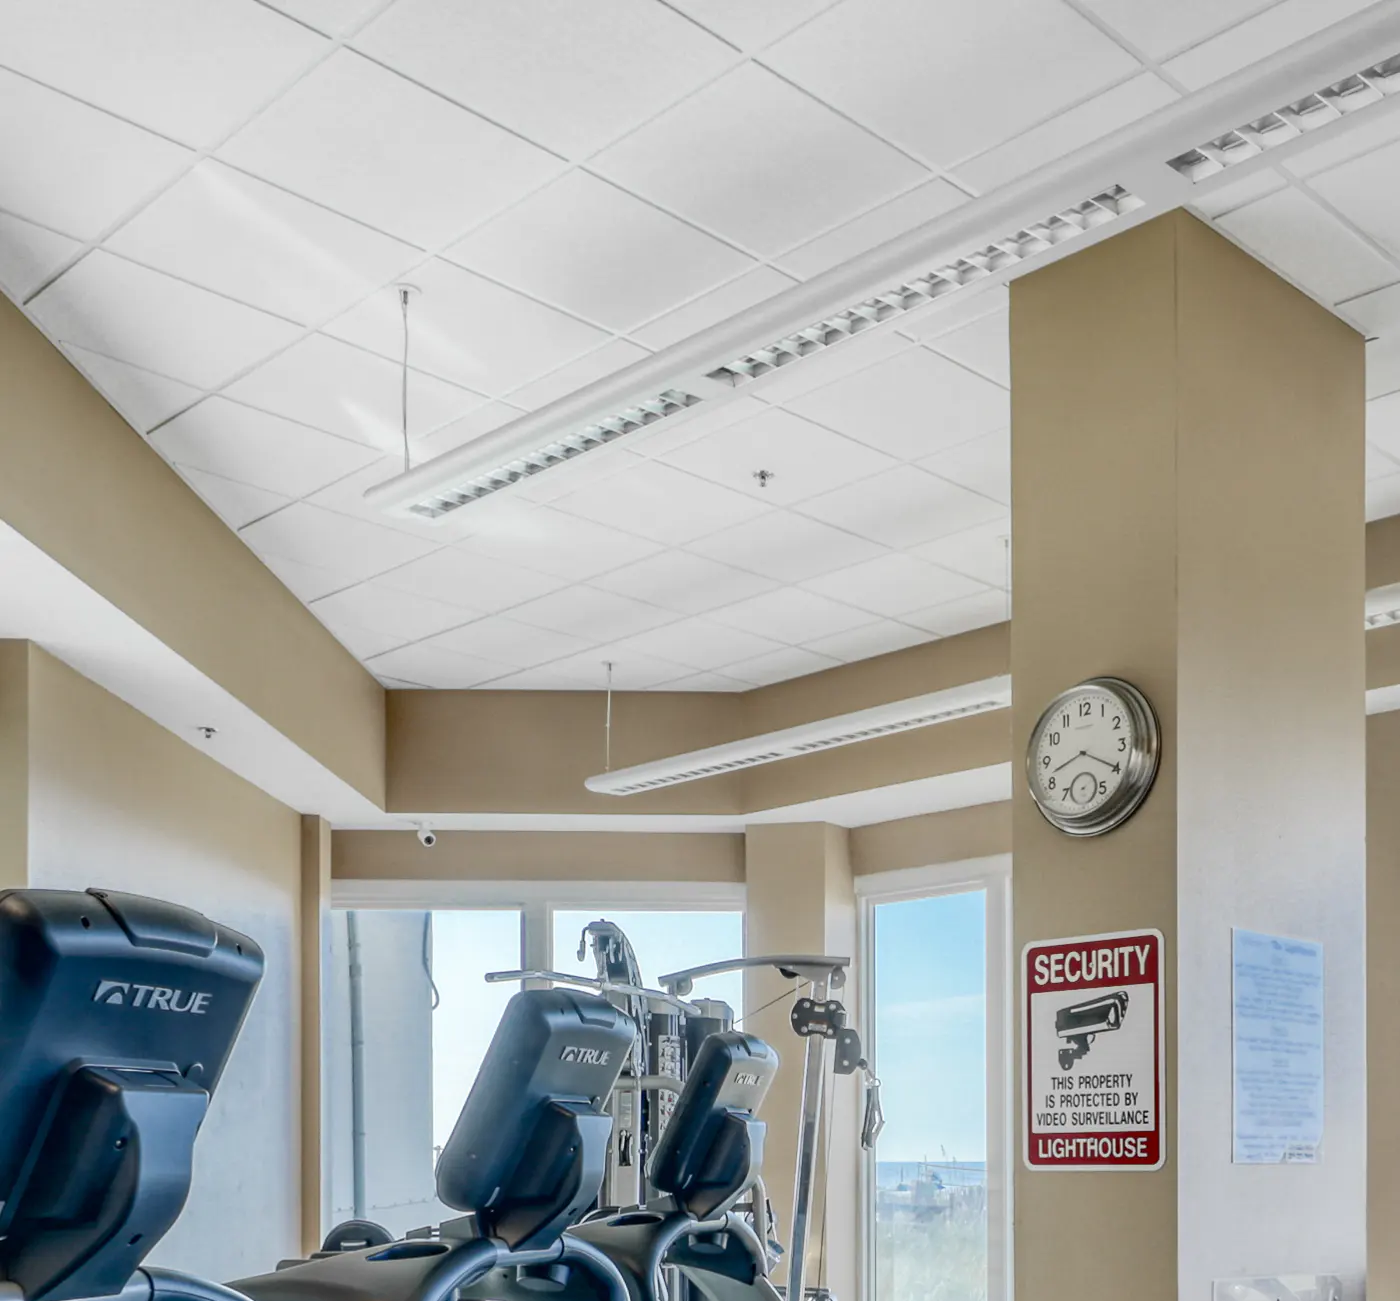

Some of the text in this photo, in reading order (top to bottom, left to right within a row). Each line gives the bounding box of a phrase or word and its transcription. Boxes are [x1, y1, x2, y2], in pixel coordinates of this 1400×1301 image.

[1079, 702, 1092, 717] 12
[1101, 703, 1105, 717] 1
[1063, 713, 1070, 728] 11
[1112, 716, 1121, 730] 2
[1049, 732, 1061, 746] 10
[1118, 737, 1127, 752] 3
[1042, 755, 1052, 770] 9
[1112, 761, 1122, 775] 4
[1048, 776, 1057, 790] 8
[1098, 781, 1107, 795] 5
[1062, 787, 1071, 801] 7
[1034, 944, 1151, 986] SECURITY
[132, 984, 213, 1014] TRUE
[576, 1047, 611, 1066] TRUE
[1051, 1073, 1133, 1091] THIS PROPERTY
[1045, 1092, 1138, 1109] IS PROTECTED BY
[1036, 1110, 1149, 1127] VIDEO SURVEILLANCE
[1038, 1137, 1149, 1159] LIGHTHOUSE
